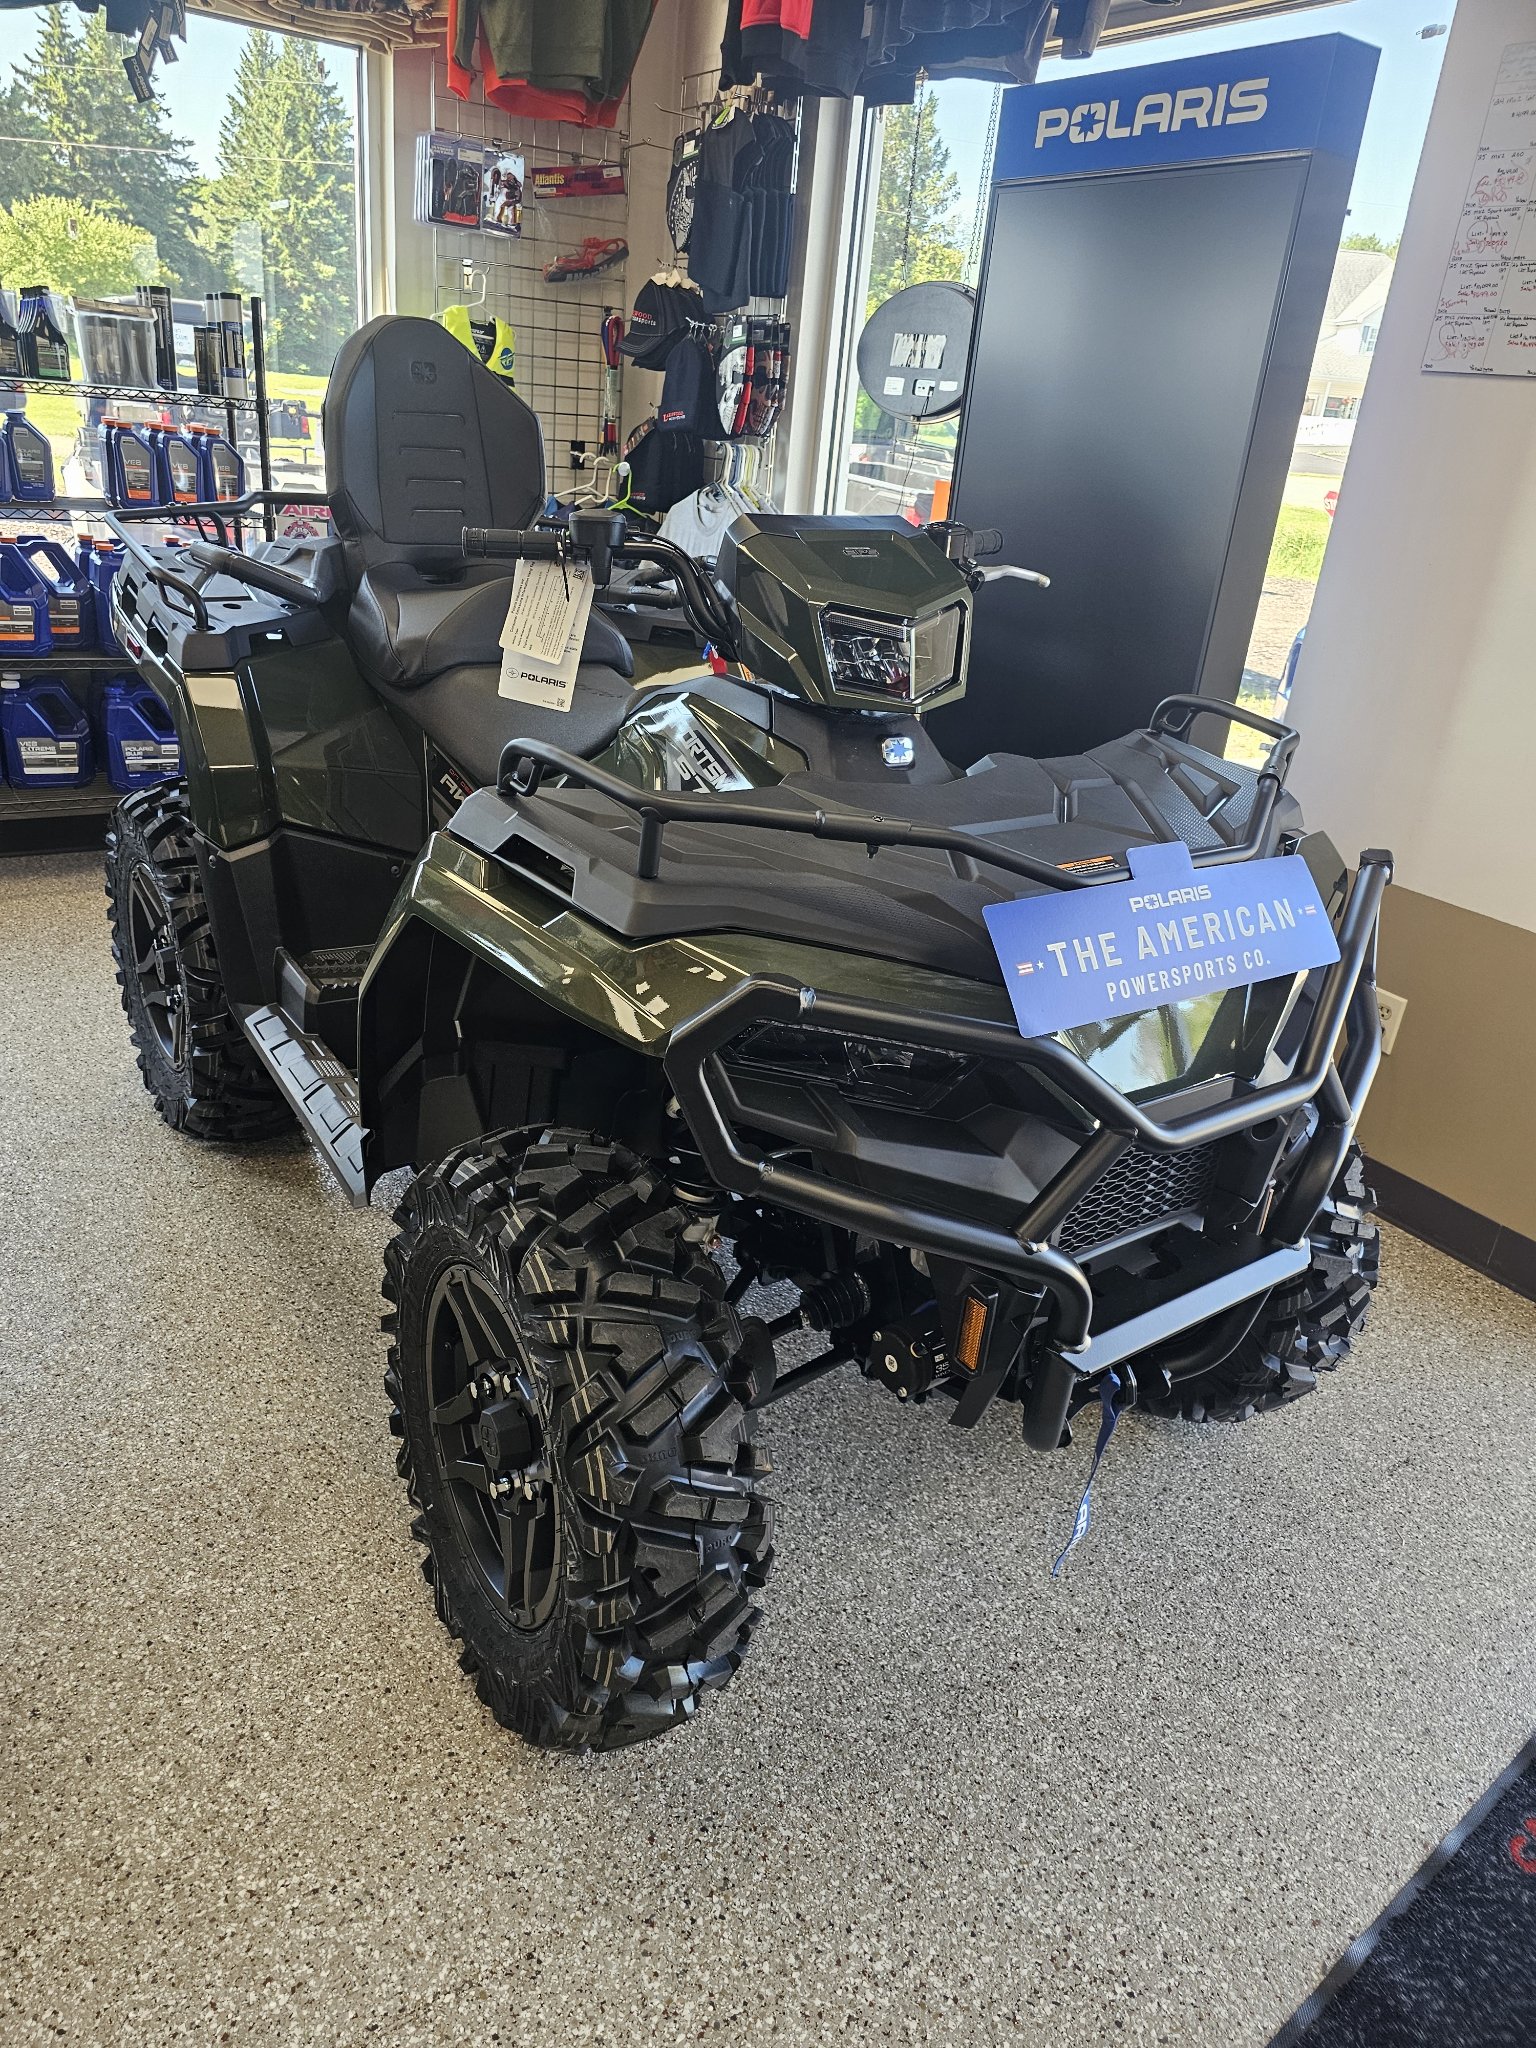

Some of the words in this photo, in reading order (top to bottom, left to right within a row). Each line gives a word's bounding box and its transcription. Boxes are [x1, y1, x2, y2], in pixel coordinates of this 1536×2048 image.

[1034, 77, 1270, 149] POLARIS
[534, 173, 565, 186] Atlantis
[520, 672, 567, 689] POLARIS
[1129, 884, 1212, 913] POLARIS
[1047, 931, 1123, 977] THE
[1137, 898, 1296, 961] AMERICAN
[1106, 956, 1237, 1002] POWERSPORTS
[1243, 949, 1271, 970] CO.
